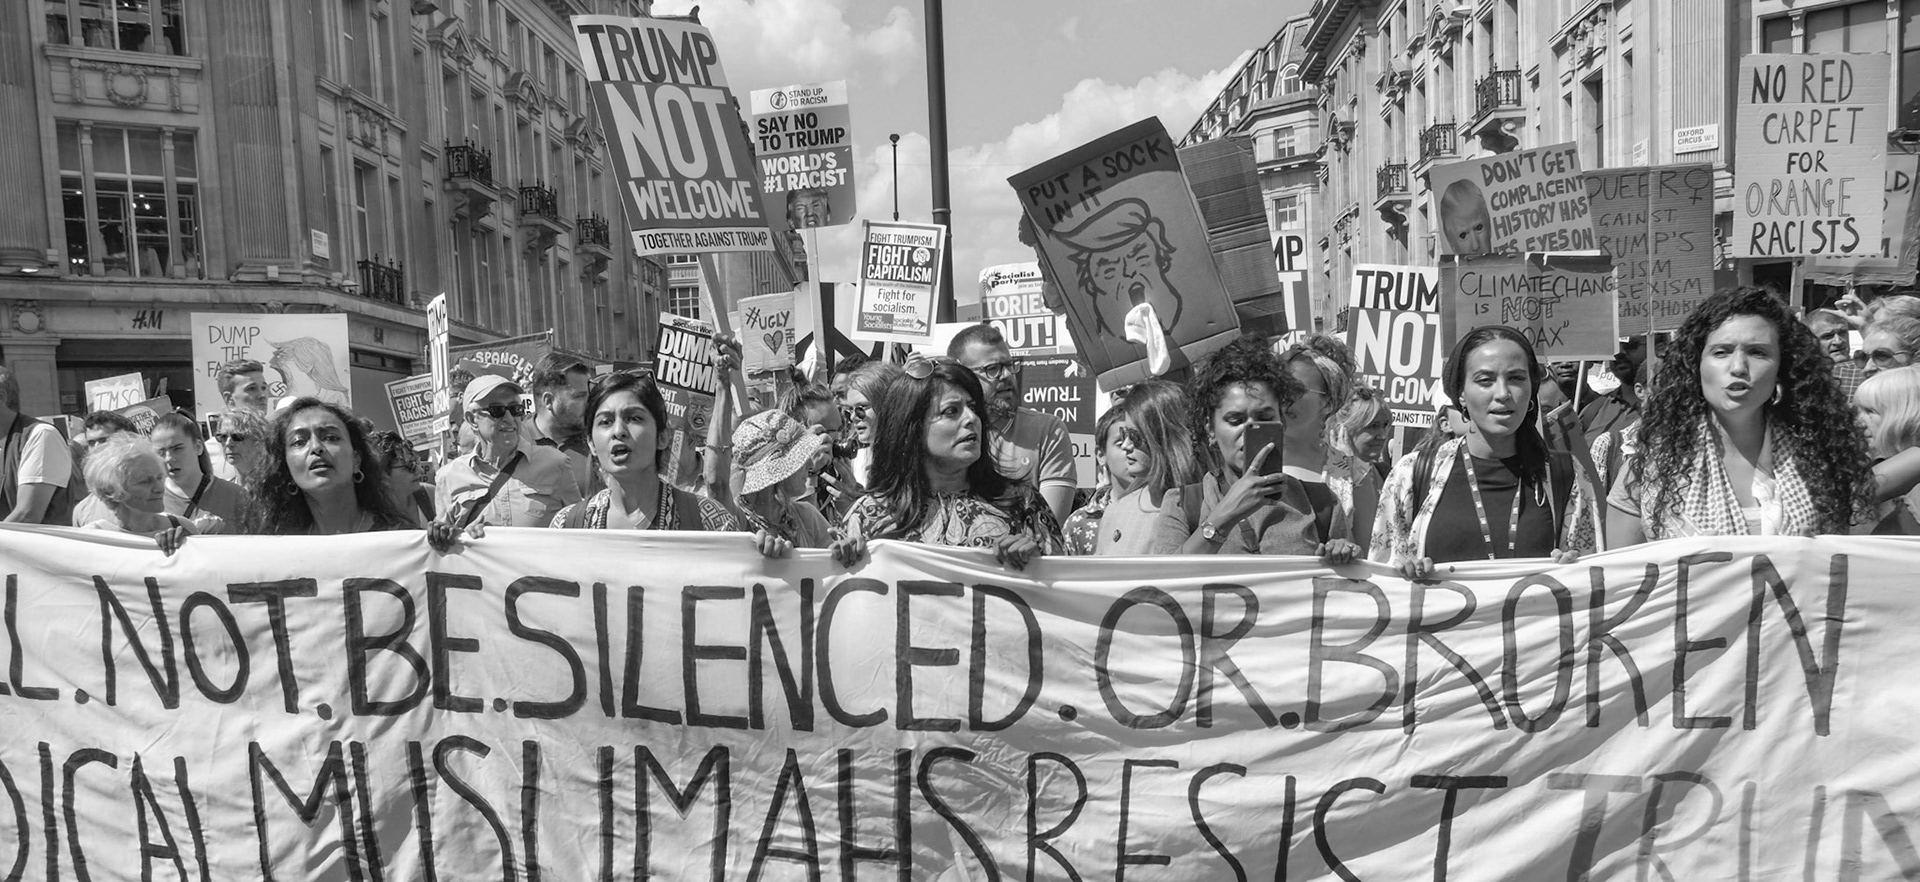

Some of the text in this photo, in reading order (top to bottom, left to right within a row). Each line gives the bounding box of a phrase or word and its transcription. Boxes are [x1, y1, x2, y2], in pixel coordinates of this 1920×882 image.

[577, 25, 717, 86] TRUMP
[789, 88, 823, 98] STAND UP
[1751, 59, 1853, 104] NO RED
[789, 96, 828, 107] TO RACISM
[604, 83, 738, 179] NOT
[758, 112, 818, 134] SAY NO
[1678, 128, 1704, 138] OXFORD
[1763, 107, 1864, 144] CARPET
[759, 127, 846, 151] TO TRUMP
[1678, 135, 1703, 145] CIRCUS
[761, 152, 837, 176] WORLD'S
[1028, 138, 1169, 206] PUT A SOCK
[1481, 149, 1576, 187] DON'T GET
[1787, 150, 1828, 174] FOR
[763, 168, 847, 194] #1 RACIST
[1585, 170, 1679, 207] QUEER
[628, 179, 760, 221] WELCOME
[1491, 175, 1584, 211] COMPLACENT
[1746, 177, 1855, 218] ORANGE
[1044, 186, 1103, 225] IN IT
[1492, 196, 1588, 240] HISTORY HAS
[1600, 208, 1678, 227] GAINST
[639, 230, 768, 249] TOGETHER AGAINST TRUMP
[870, 232, 933, 247] FIGHT TRUMPISM
[1571, 228, 1594, 250] ON
[1600, 231, 1695, 258] RUMP'S
[1750, 217, 1860, 255] RACISTS
[868, 244, 911, 266] FIGHT
[867, 263, 933, 283] CAPITALISM
[994, 271, 1035, 281] Socialist
[1617, 259, 1671, 280] CISM
[878, 288, 916, 302] Fight for
[991, 278, 1019, 289] Party
[1356, 269, 1439, 312] TRUM
[1460, 271, 1553, 298] CLIMATE
[132, 309, 163, 330] H&M
[745, 306, 791, 331] #UGLY
[873, 302, 918, 315] socialism.
[1475, 296, 1561, 324] IS NOT
[208, 325, 261, 346] DUMP
[672, 318, 713, 335] Socialist Wor
[221, 346, 250, 362] THE
[396, 393, 422, 411] FIGHT
[1024, 386, 1081, 403] TRUMP
[1391, 410, 1419, 425] GAINST
[1303, 552, 1849, 736] BROKEN
